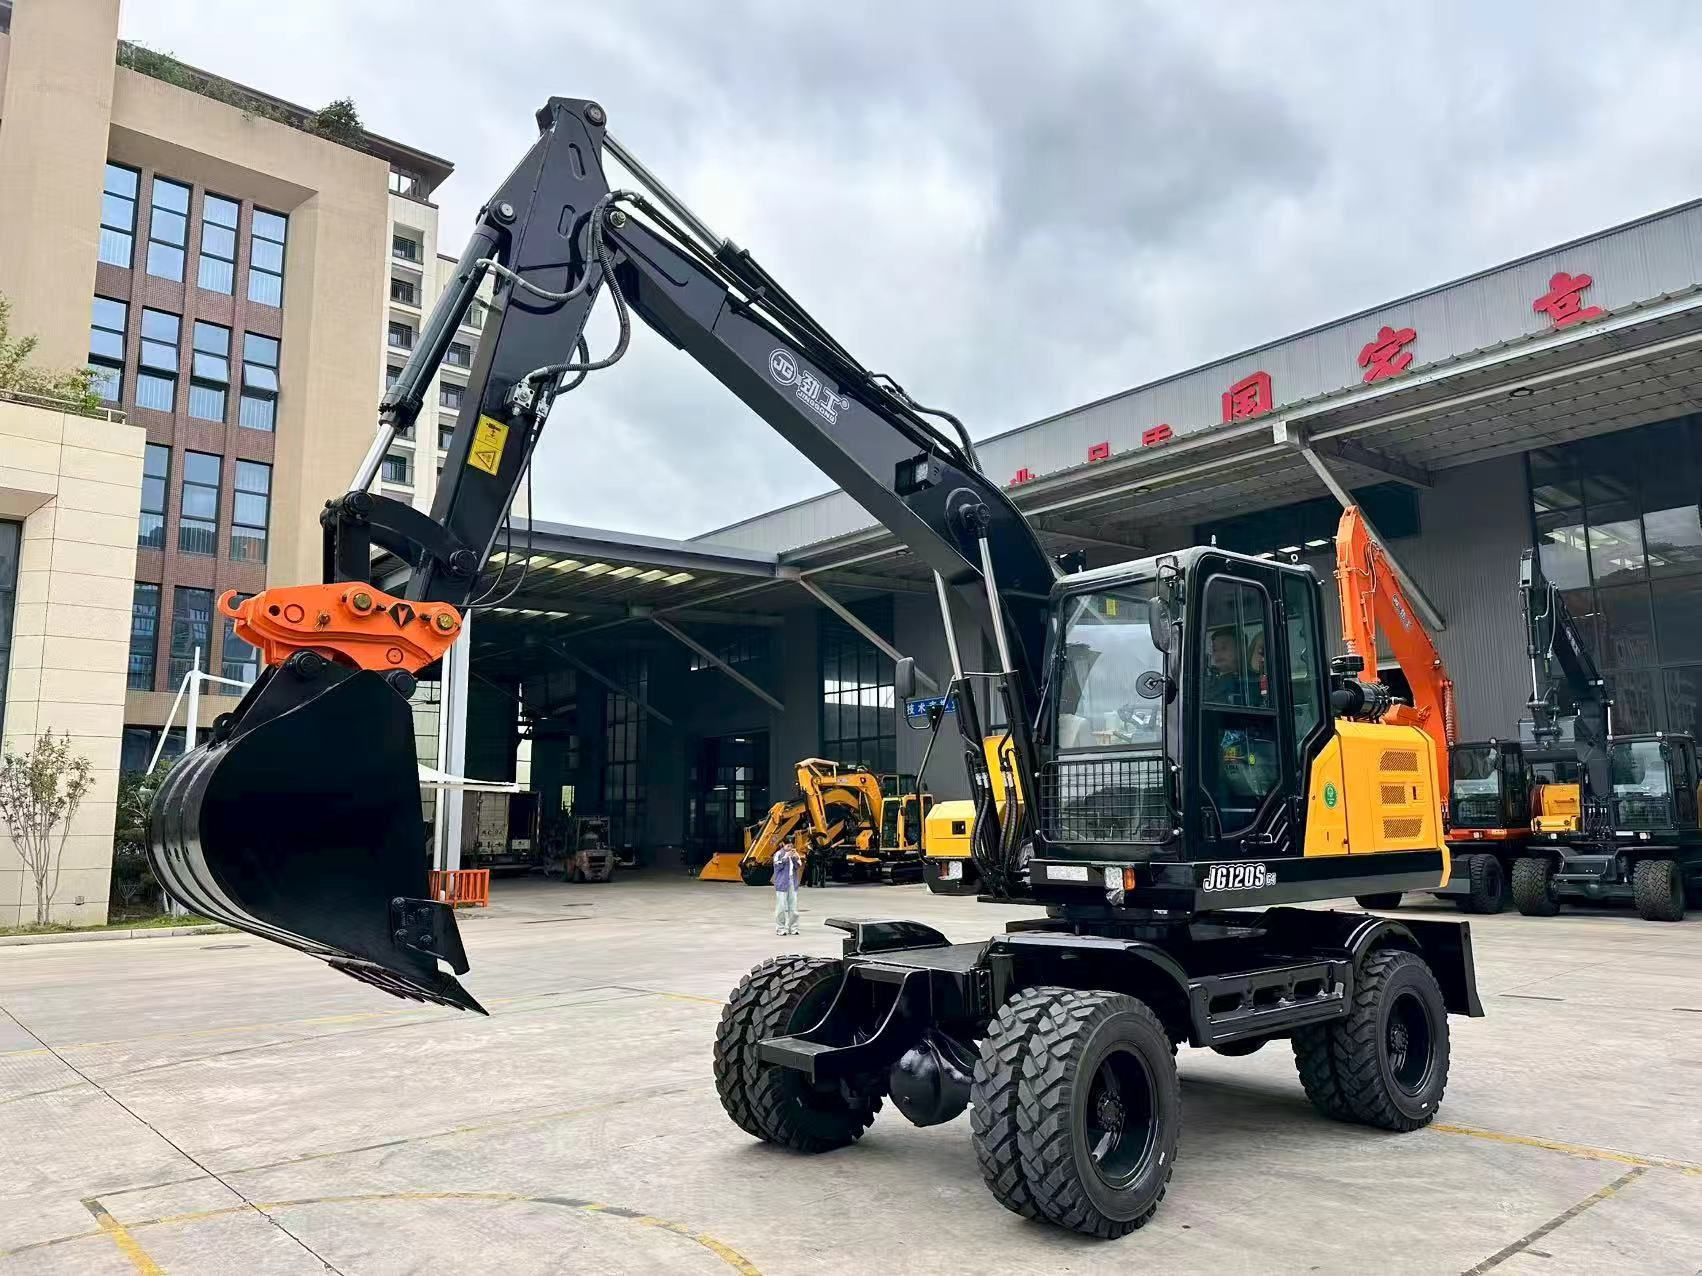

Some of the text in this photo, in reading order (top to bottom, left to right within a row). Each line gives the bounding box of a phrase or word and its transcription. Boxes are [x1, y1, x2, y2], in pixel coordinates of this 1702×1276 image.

[773, 355, 794, 379] JG
[800, 372, 839, 415] 劲工
[1203, 863, 1266, 892] JG120S
